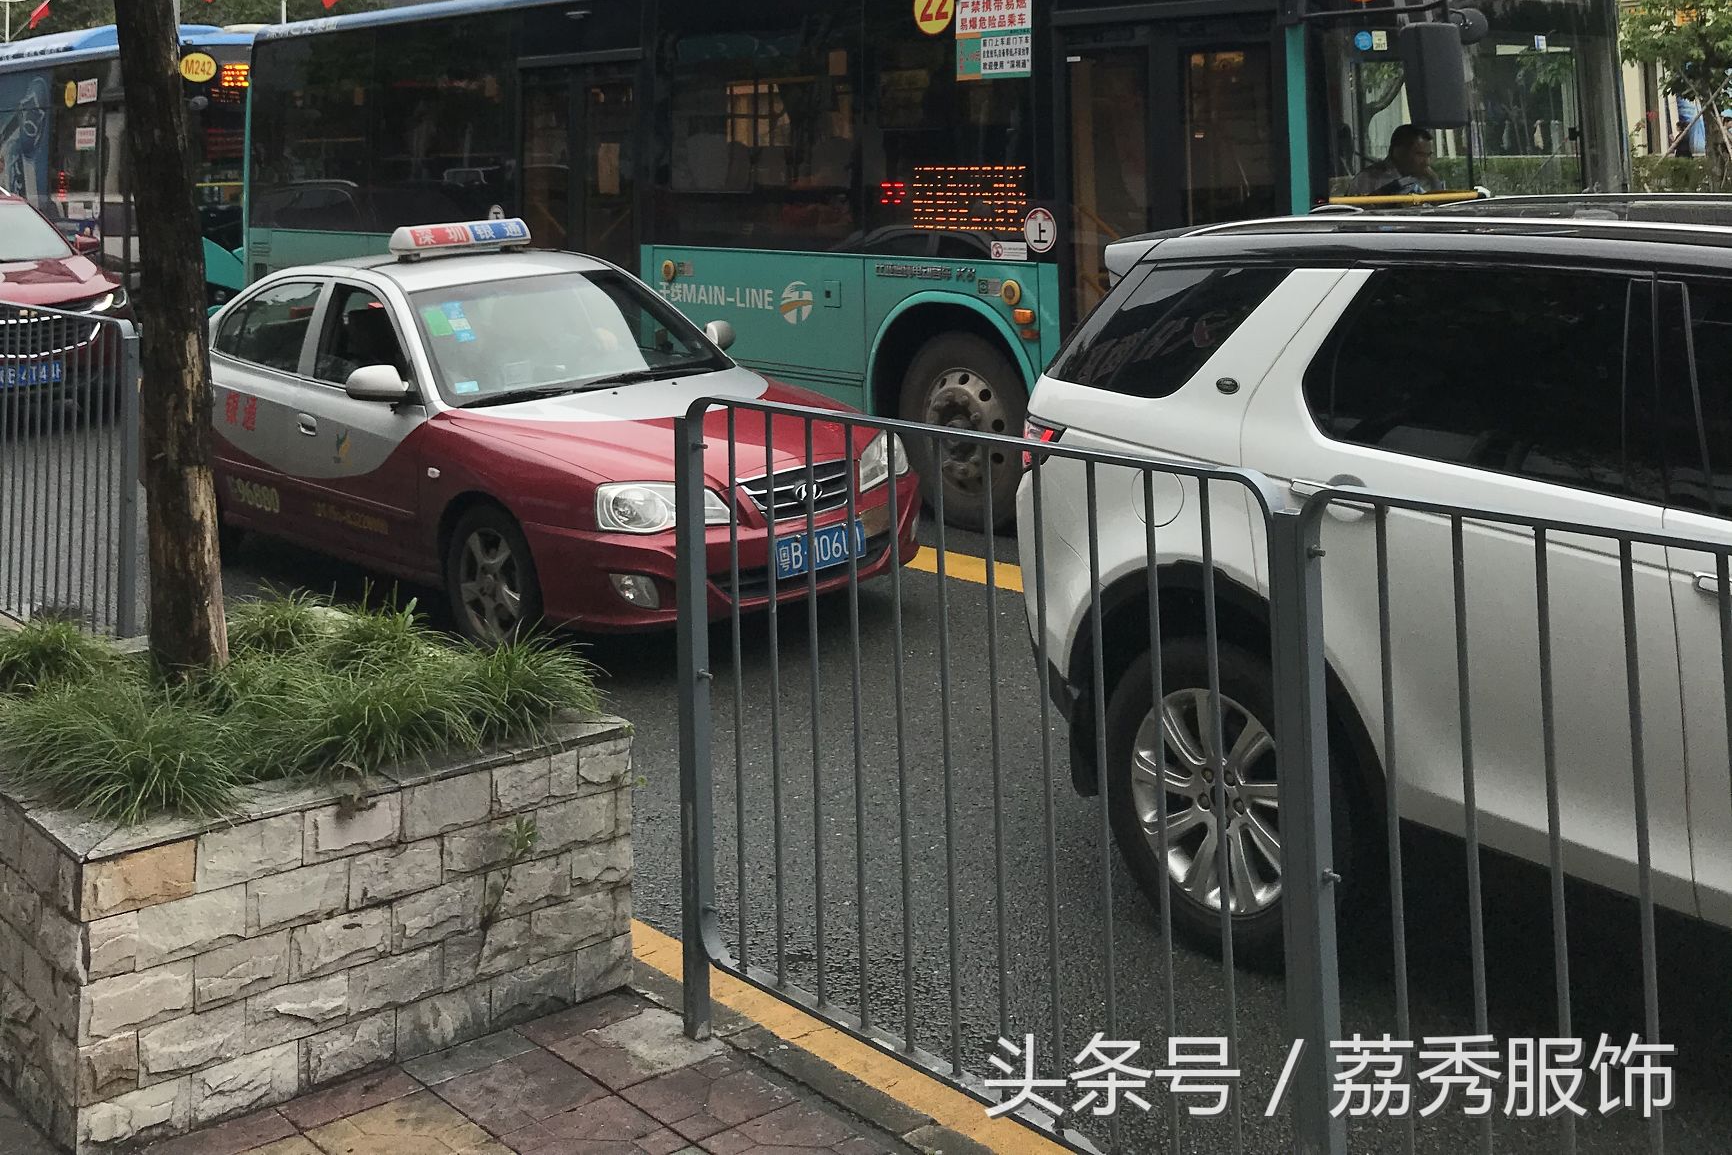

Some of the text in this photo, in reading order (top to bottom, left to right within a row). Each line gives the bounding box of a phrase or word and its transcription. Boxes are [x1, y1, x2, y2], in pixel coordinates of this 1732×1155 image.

[960, 13, 1026, 31] 易爆危险品乘车
[185, 60, 212, 76] M242
[1033, 223, 1048, 243] 上
